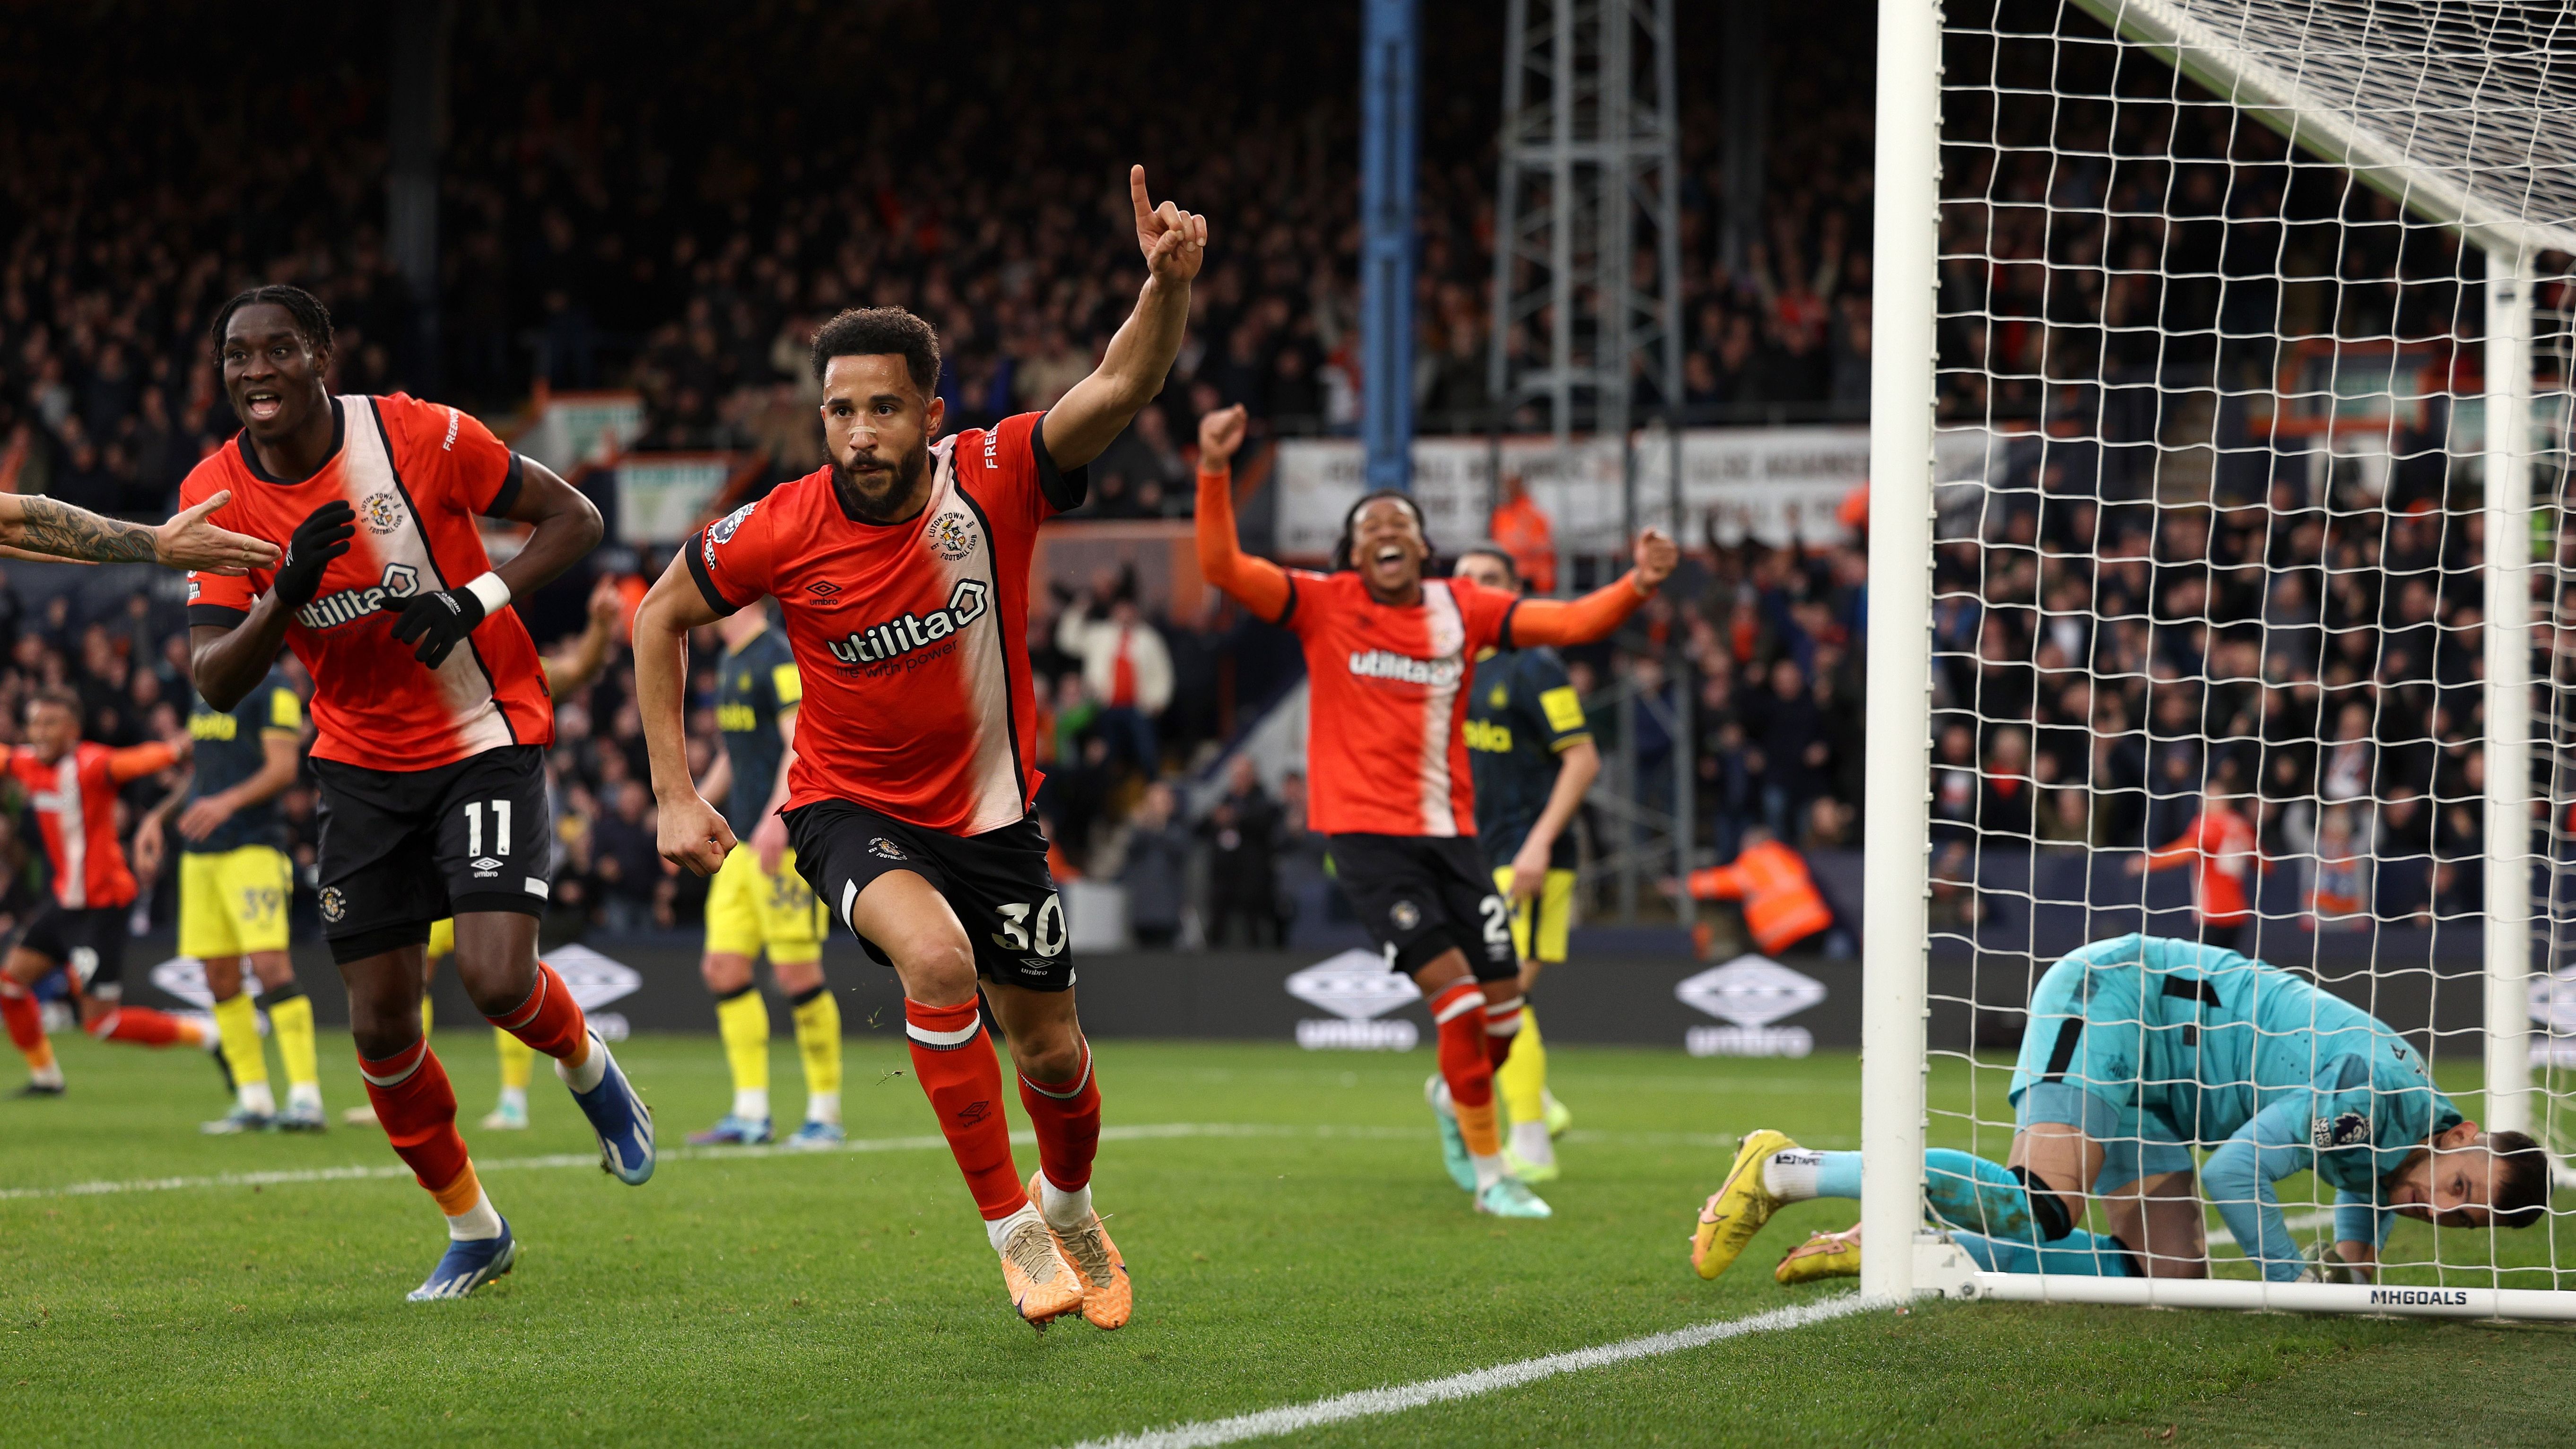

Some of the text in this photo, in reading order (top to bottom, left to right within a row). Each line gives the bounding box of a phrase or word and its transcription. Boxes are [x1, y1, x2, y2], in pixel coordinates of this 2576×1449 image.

[361, 493, 393, 512] LUTON TOWN
[369, 515, 403, 535] FOOTBALL CLUB
[929, 517, 943, 538] LUTON
[940, 534, 977, 561] FOOTBALL CLUB
[296, 588, 386, 628] utilita
[827, 612, 954, 662] utilita
[864, 662, 901, 677] with
[905, 639, 958, 673] power
[465, 799, 511, 858] 11
[992, 893, 1067, 957] 30
[963, 1111, 992, 1128] umbro
[2371, 1290, 2467, 1305] MHGOALS
